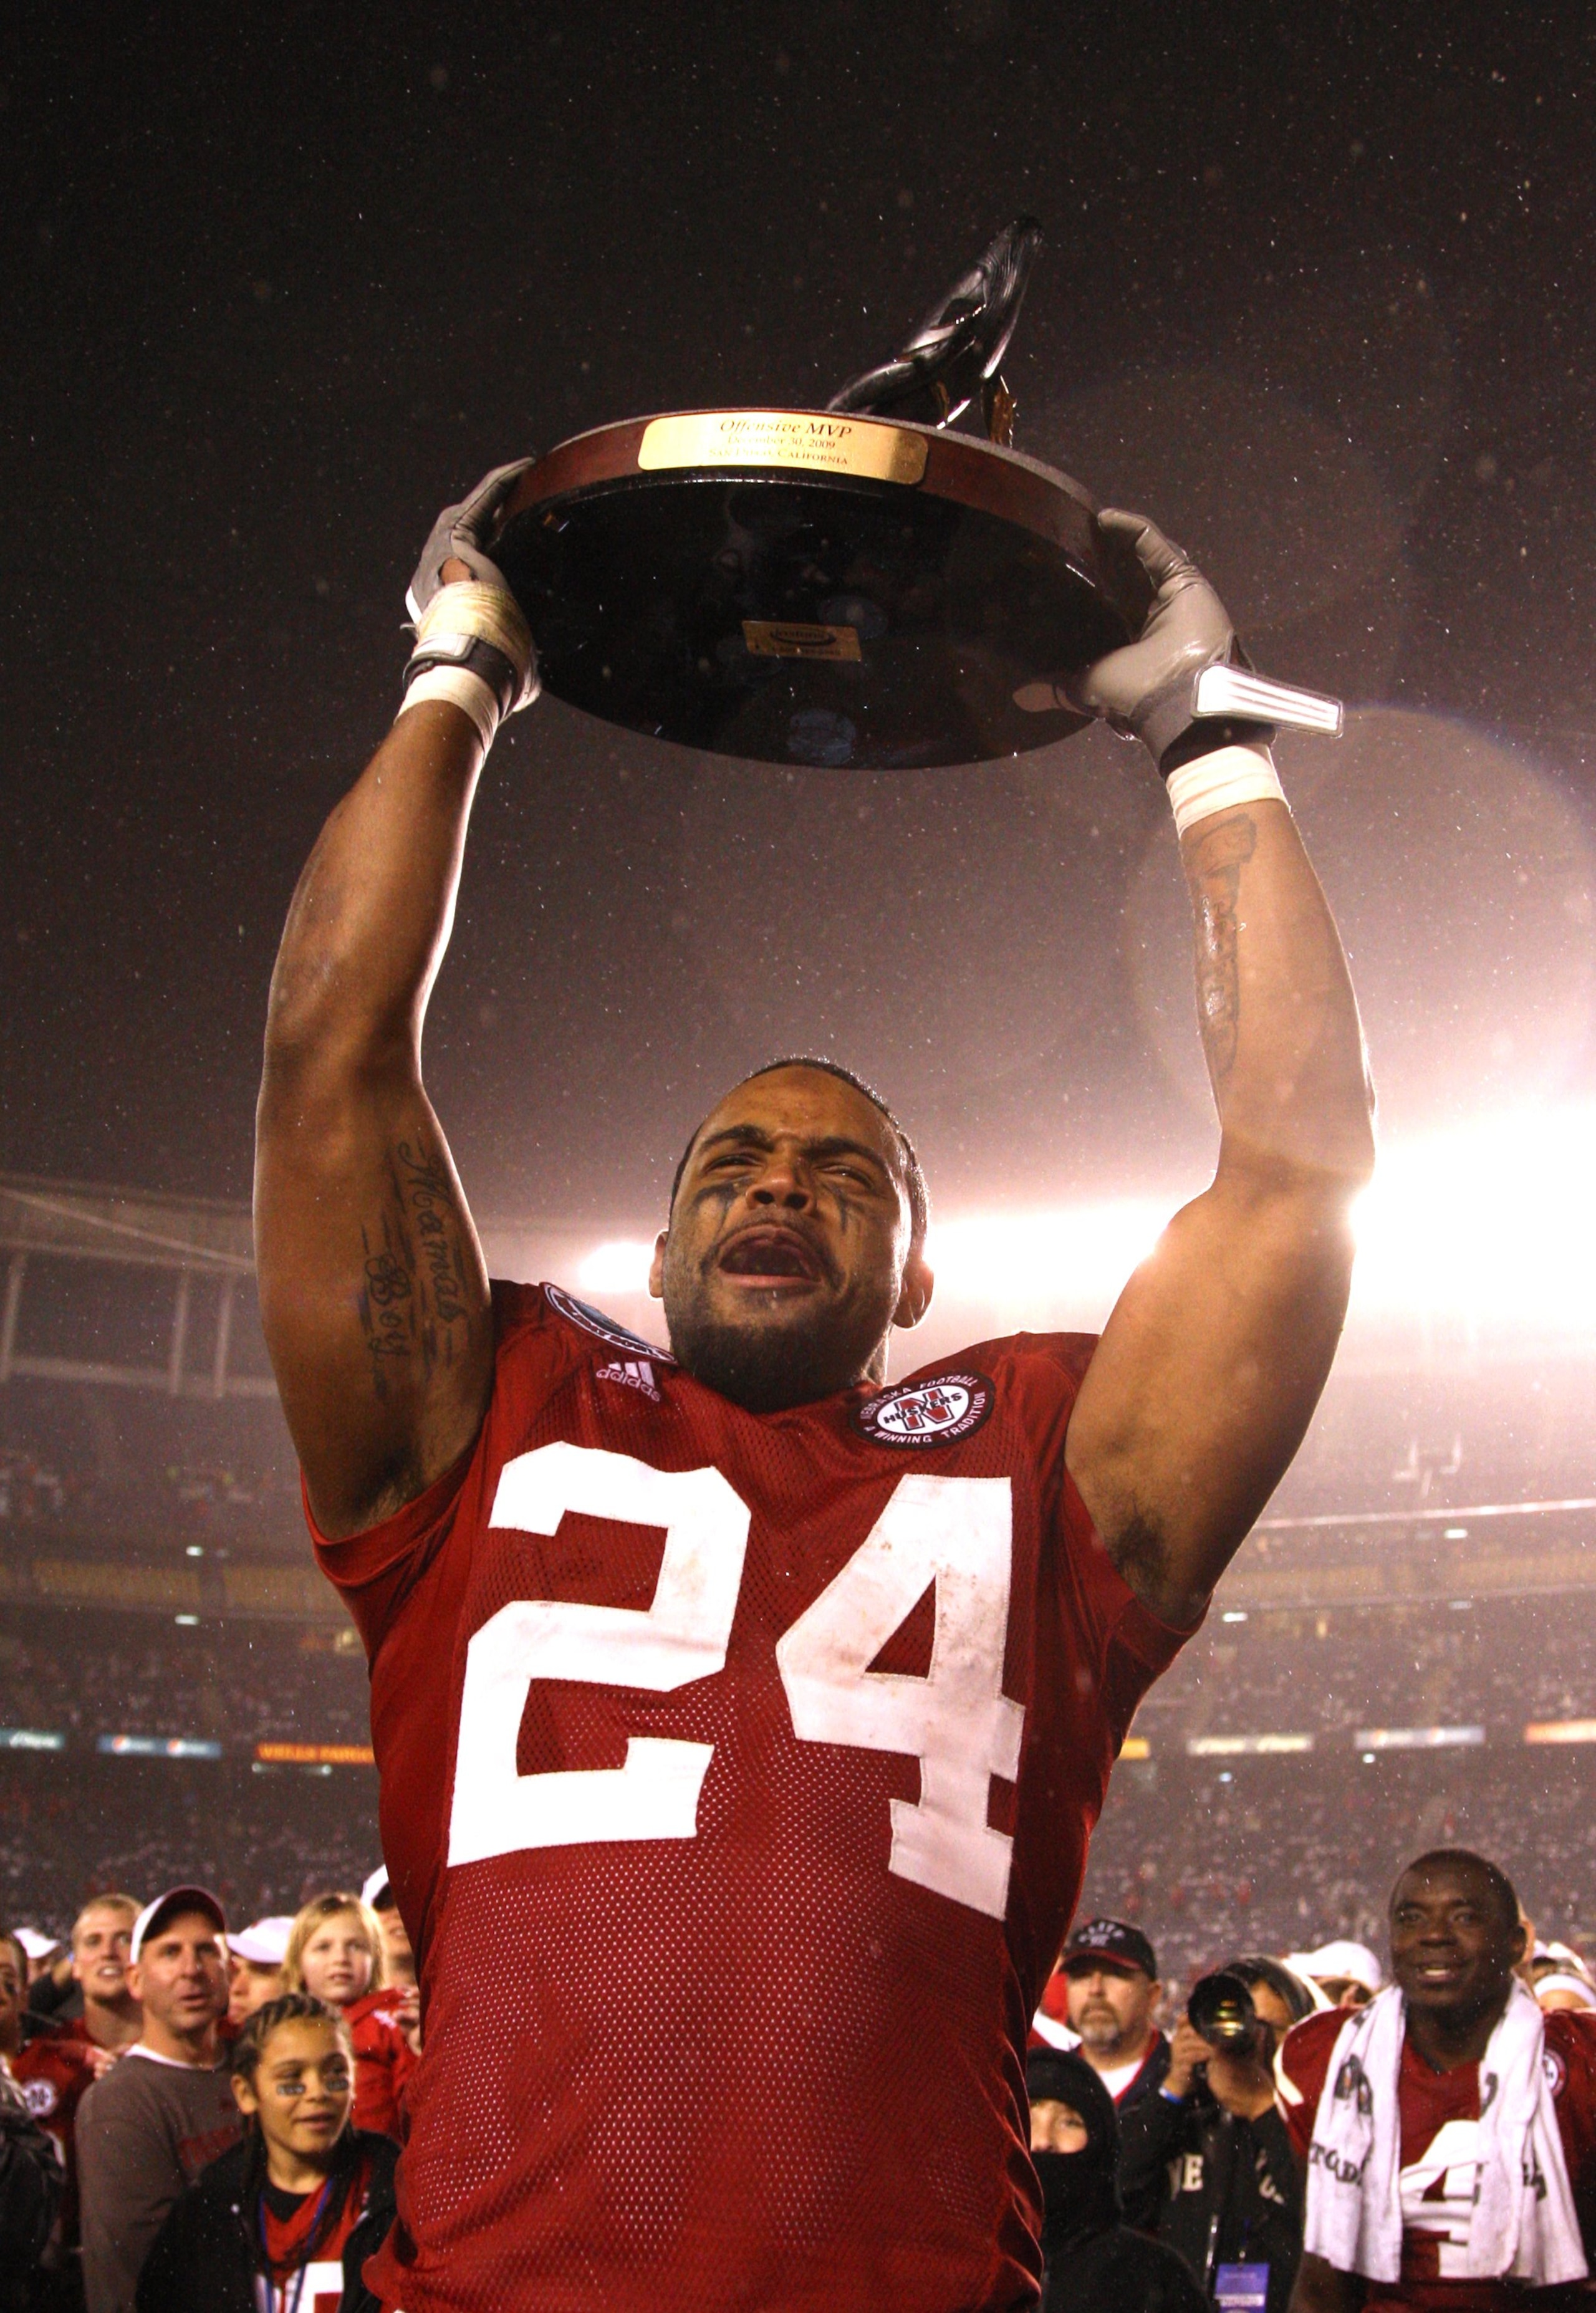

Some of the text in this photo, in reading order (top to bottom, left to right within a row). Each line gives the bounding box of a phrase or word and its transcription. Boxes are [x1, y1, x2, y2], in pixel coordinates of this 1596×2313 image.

[720, 419, 852, 438] Offensive MVP
[728, 433, 836, 450] December 30, 2009
[777, 448, 848, 465] CALIFORNIA
[596, 1368, 661, 1402] adidas
[919, 1375, 979, 1390] FOOTBALL
[874, 1433, 933, 1444] WINNING
[940, 1391, 986, 1438] TRADITION
[883, 1392, 963, 1425] HUSKERS
[447, 1440, 1026, 1921] 24
